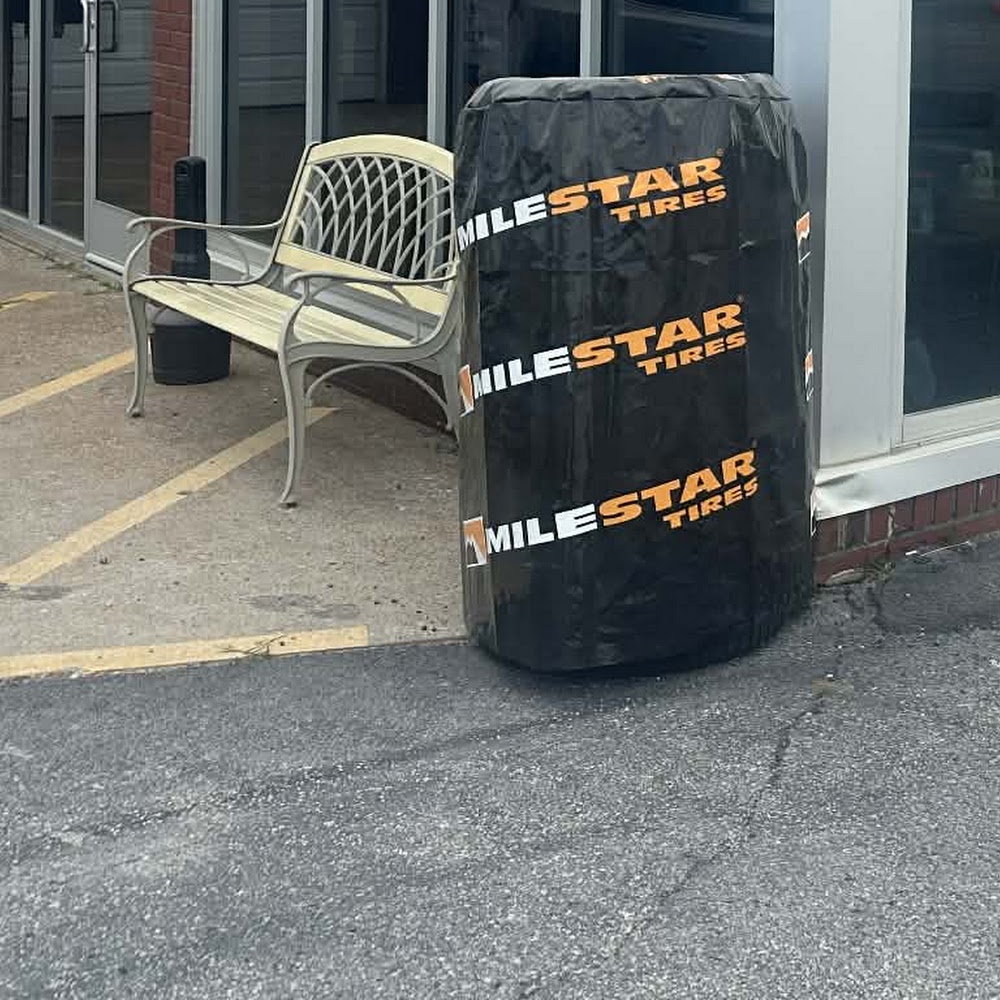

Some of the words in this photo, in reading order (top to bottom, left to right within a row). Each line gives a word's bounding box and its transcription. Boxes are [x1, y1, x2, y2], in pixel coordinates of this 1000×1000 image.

[458, 156, 723, 251] MILESTAR
[610, 184, 727, 223] TIRES
[473, 303, 743, 400] MILESTAR
[637, 331, 747, 376] TIRES
[485, 449, 757, 553] MILESTAR
[663, 476, 758, 530] TIRES
